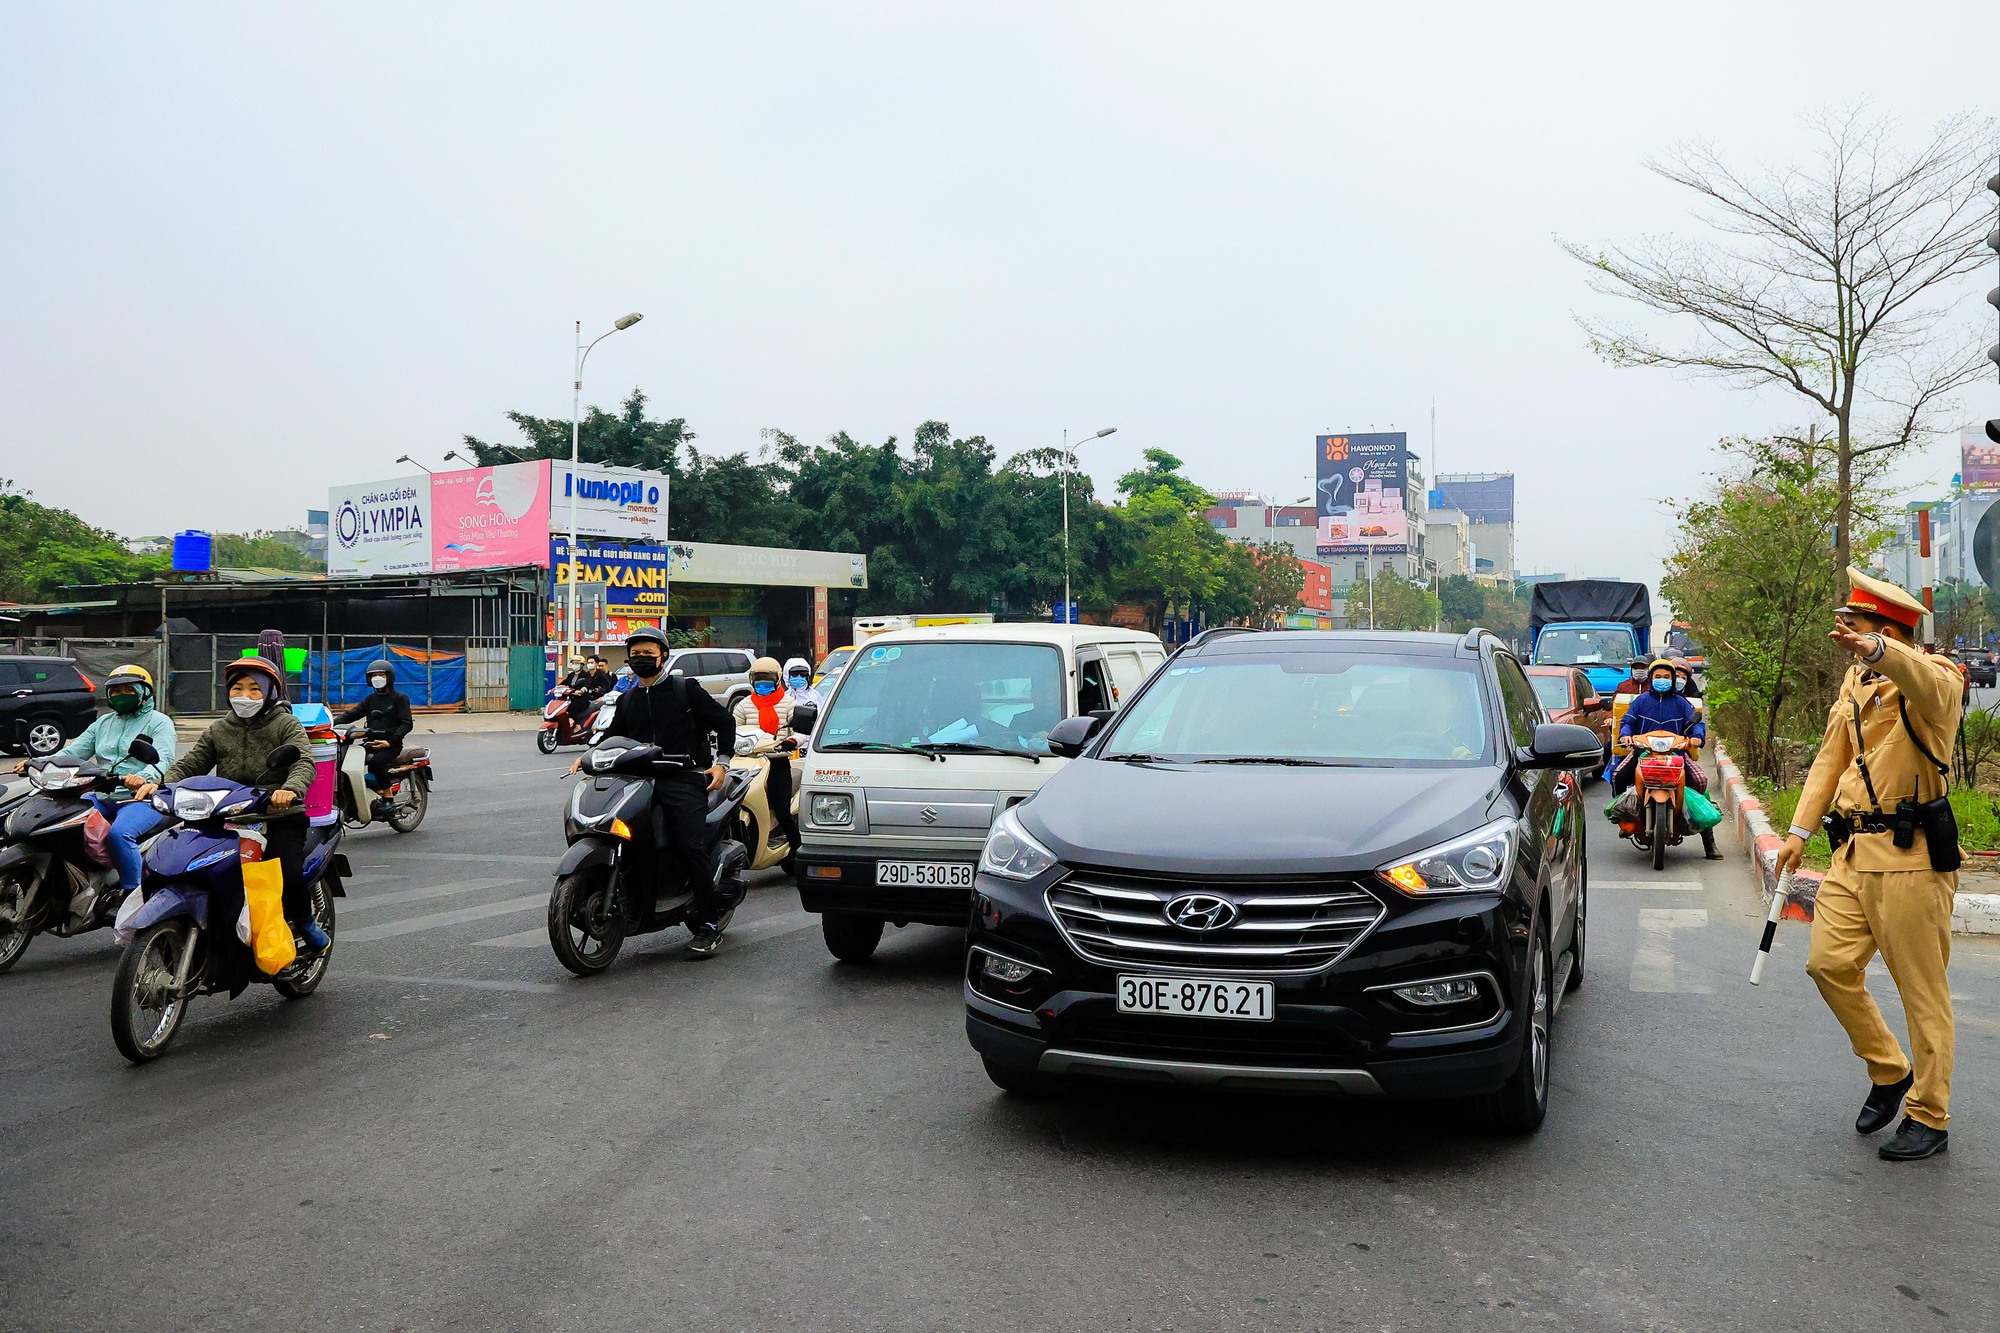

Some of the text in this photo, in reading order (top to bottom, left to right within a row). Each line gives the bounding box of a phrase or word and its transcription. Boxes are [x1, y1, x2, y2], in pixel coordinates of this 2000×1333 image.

[380, 493, 388, 502] GA
[389, 487, 401, 500] GỐI
[402, 486, 416, 500] ĐỆM
[627, 505, 658, 514] moments
[459, 514, 486, 528] SONG
[556, 546, 565, 557] HỆ
[589, 548, 602, 558] THẾ
[603, 549, 618, 558] GIỚI
[618, 550, 632, 561] ĐỆM
[633, 550, 650, 560] HÀNG
[652, 551, 666, 562] ĐẦU
[604, 565, 666, 588] XANH
[634, 592, 666, 603] .com
[814, 774, 860, 784] CARRY
[880, 864, 971, 886] 29D-530.58
[1122, 980, 1264, 1016] 30E-876.21
